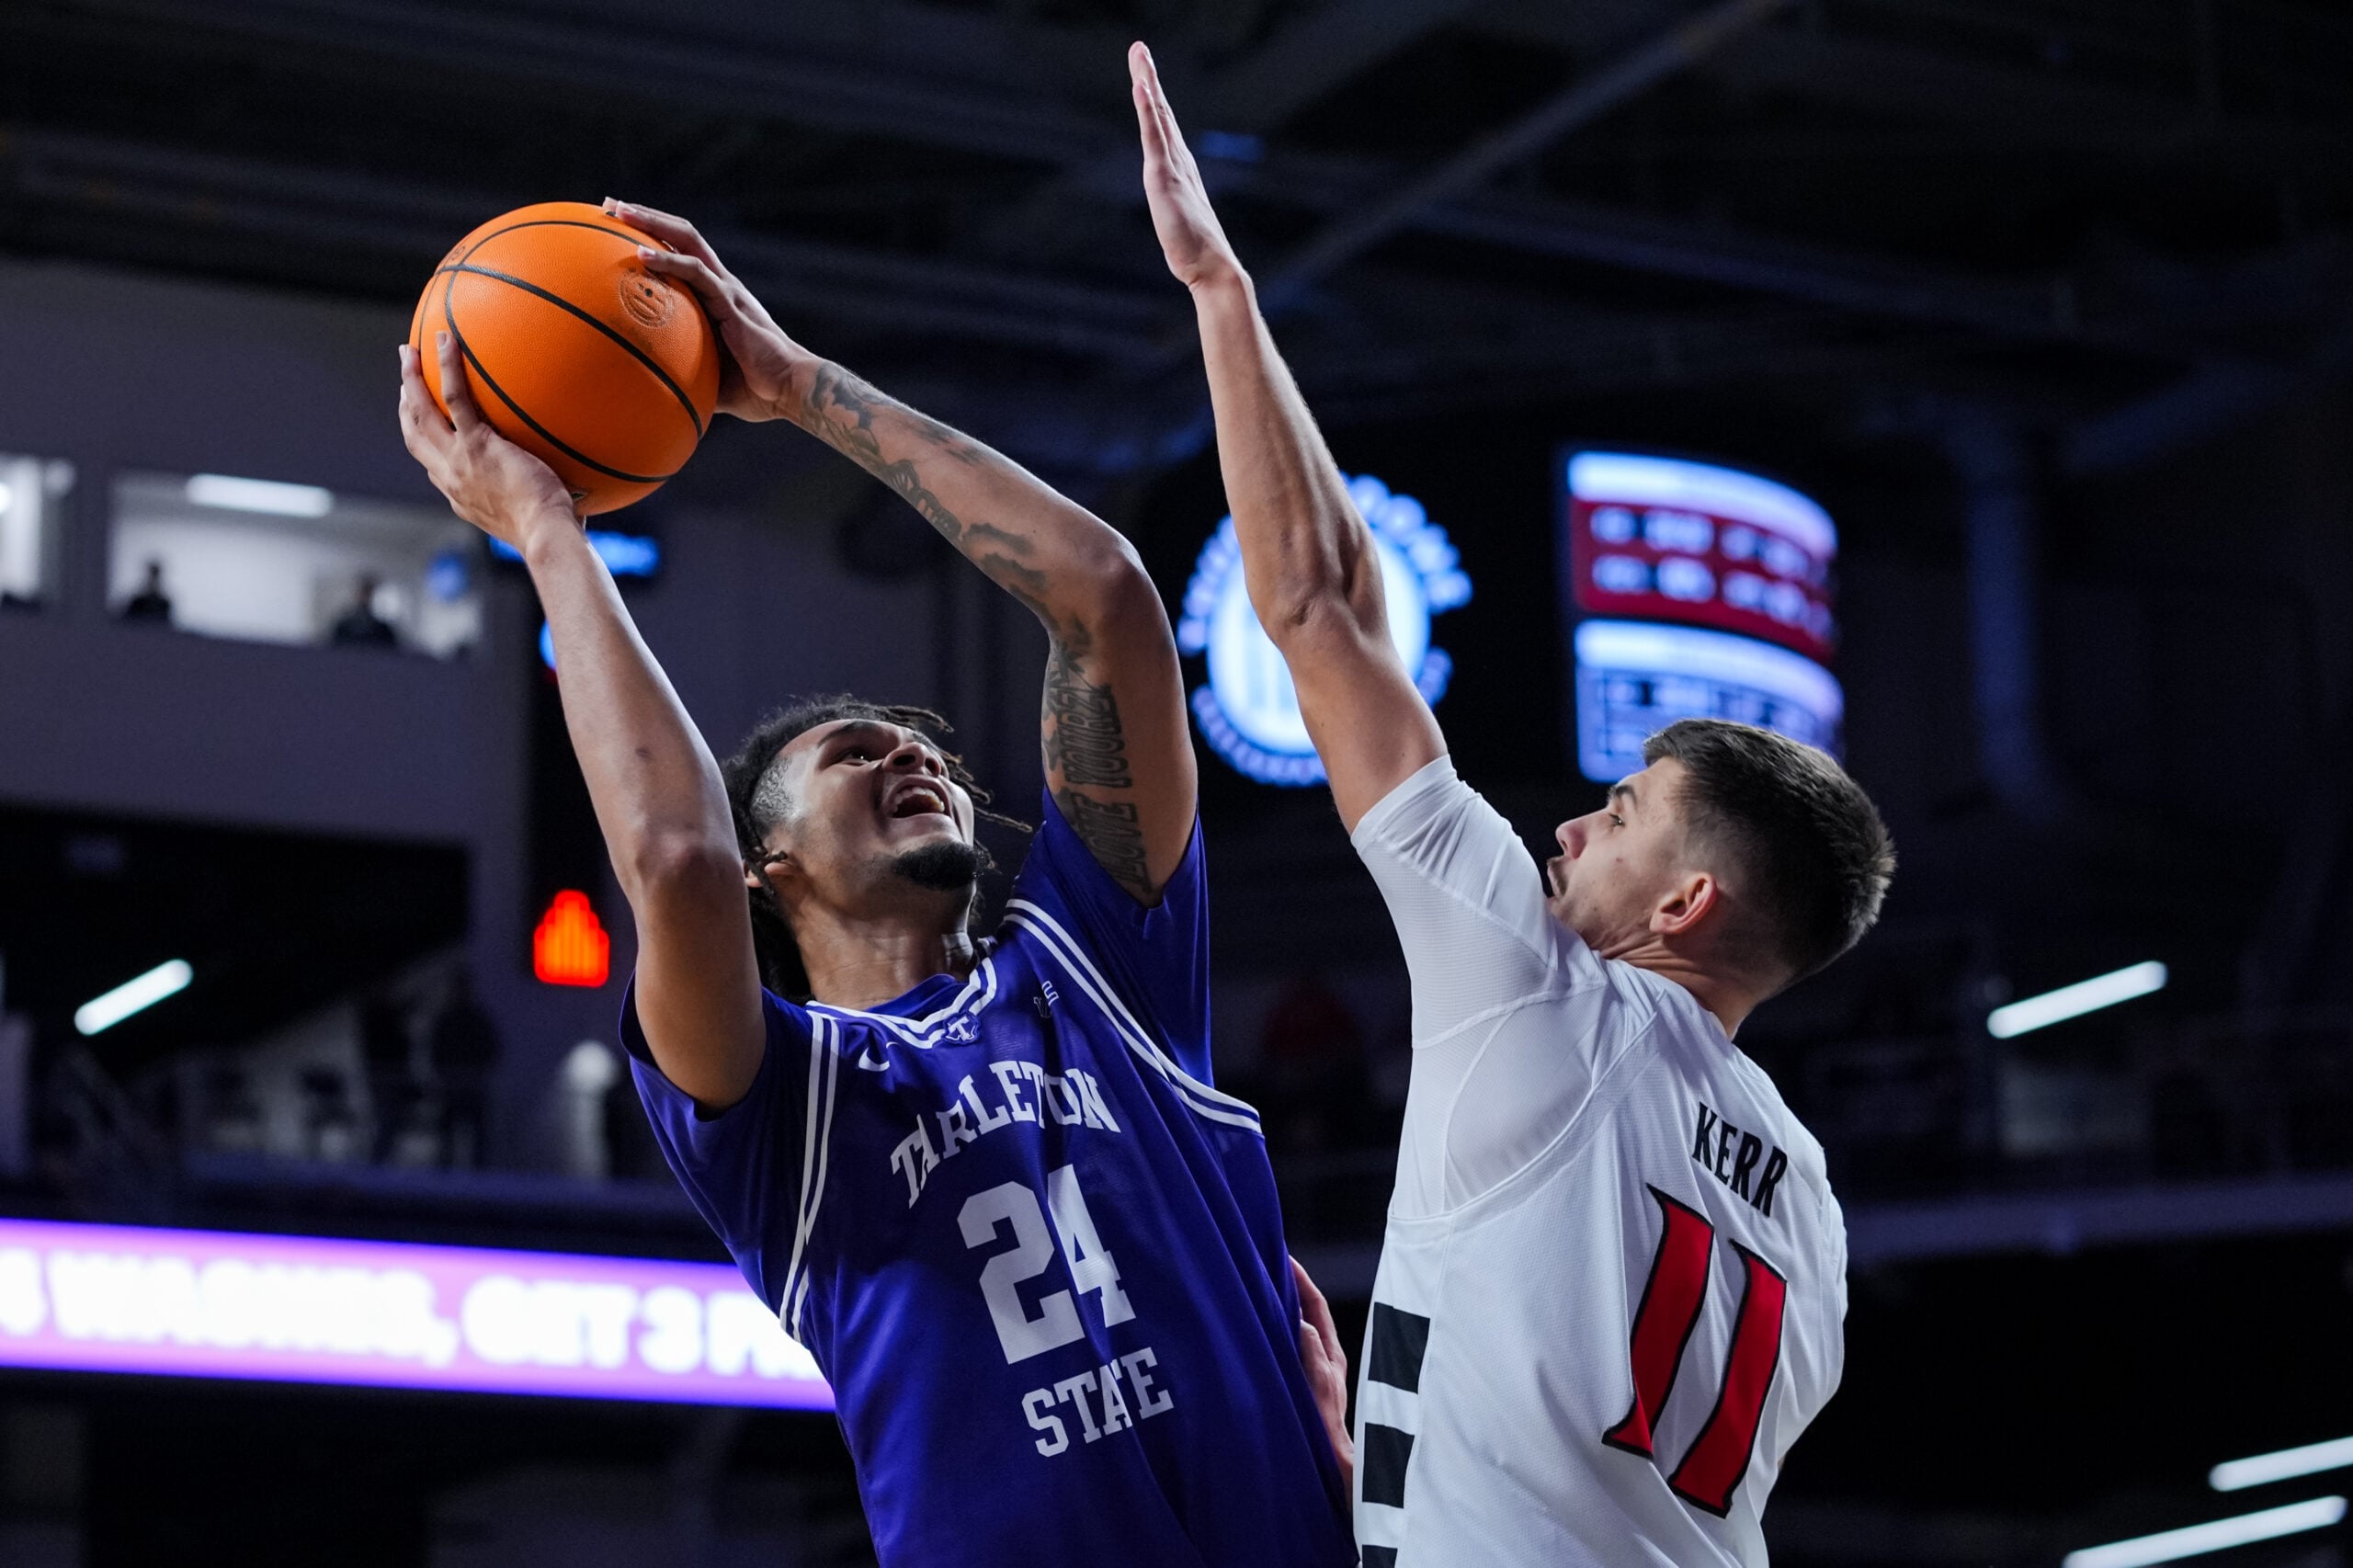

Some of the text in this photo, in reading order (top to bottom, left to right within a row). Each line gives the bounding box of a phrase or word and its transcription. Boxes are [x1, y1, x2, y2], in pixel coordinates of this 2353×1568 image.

[890, 1060, 1121, 1210] TARLETON
[1691, 1101, 1789, 1218] KERR
[957, 1164, 1137, 1365] 24
[1021, 1346, 1175, 1458] STAE
[1601, 1182, 1788, 1519] 11
